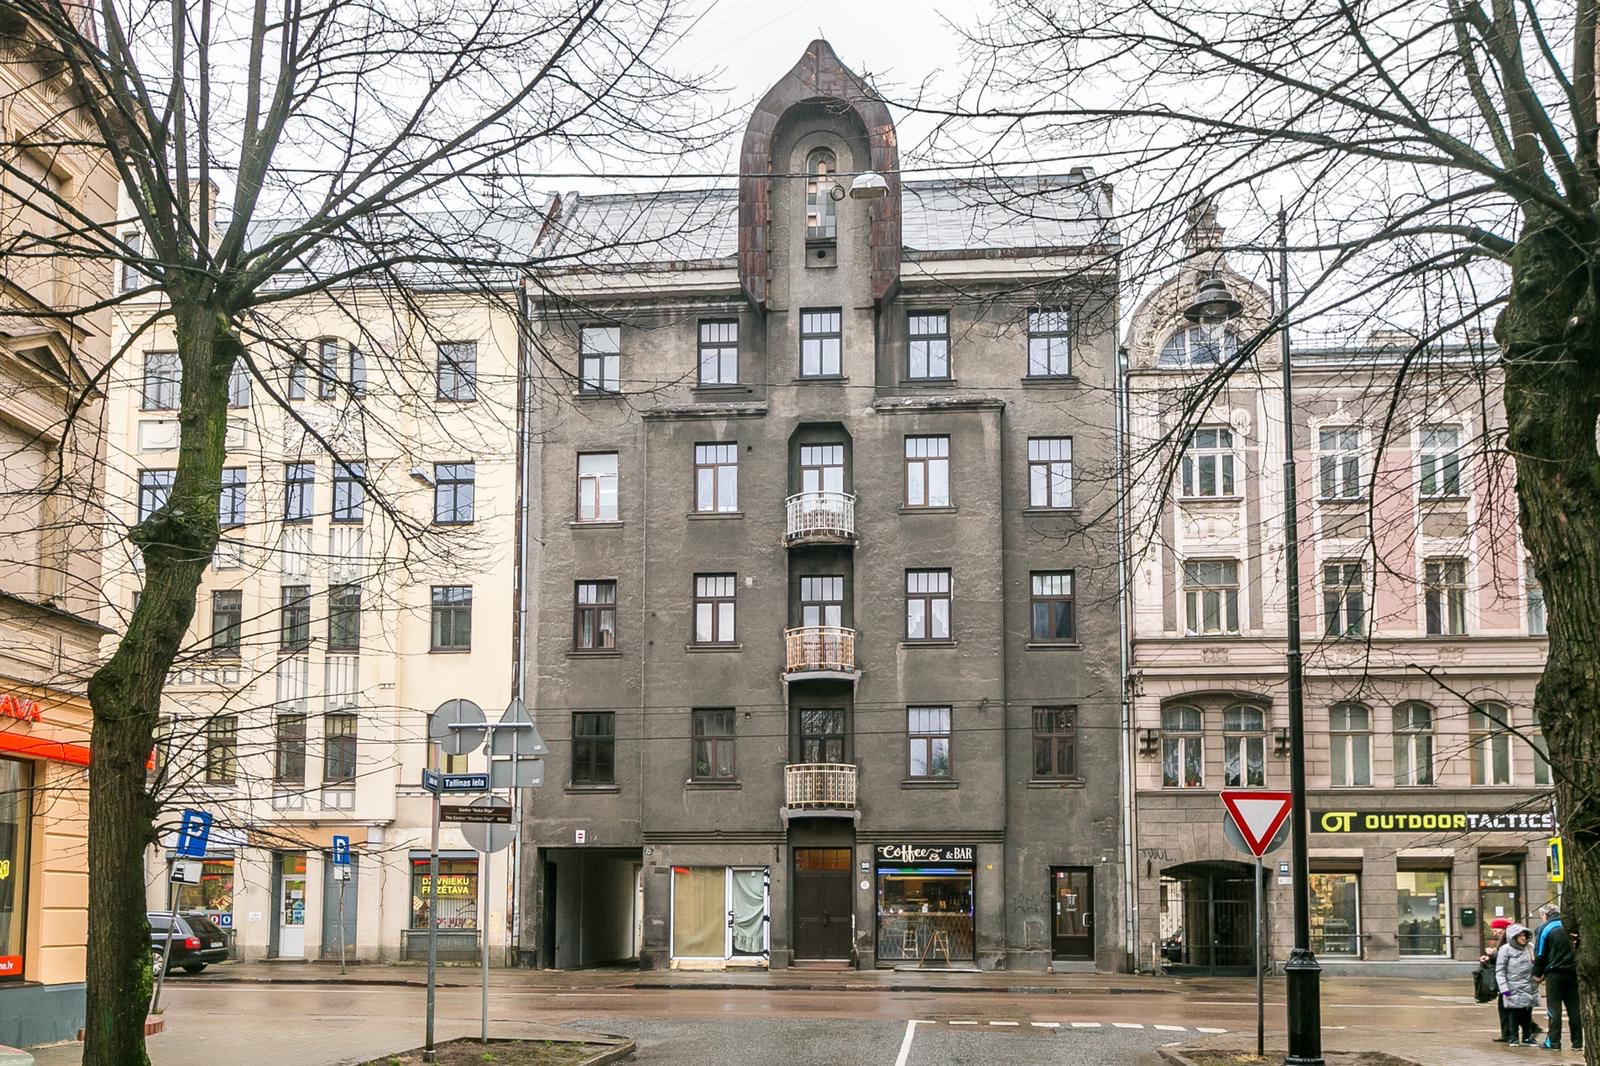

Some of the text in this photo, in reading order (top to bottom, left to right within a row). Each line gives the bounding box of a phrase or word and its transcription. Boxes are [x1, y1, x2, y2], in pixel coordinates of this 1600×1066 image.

[445, 779, 471, 787] Tallinas
[472, 778, 485, 787] iela
[184, 815, 205, 850] P
[336, 838, 347, 862] P
[877, 844, 942, 863] Coffee
[954, 847, 972, 859] BAR
[422, 877, 470, 885] DVNIEKU
